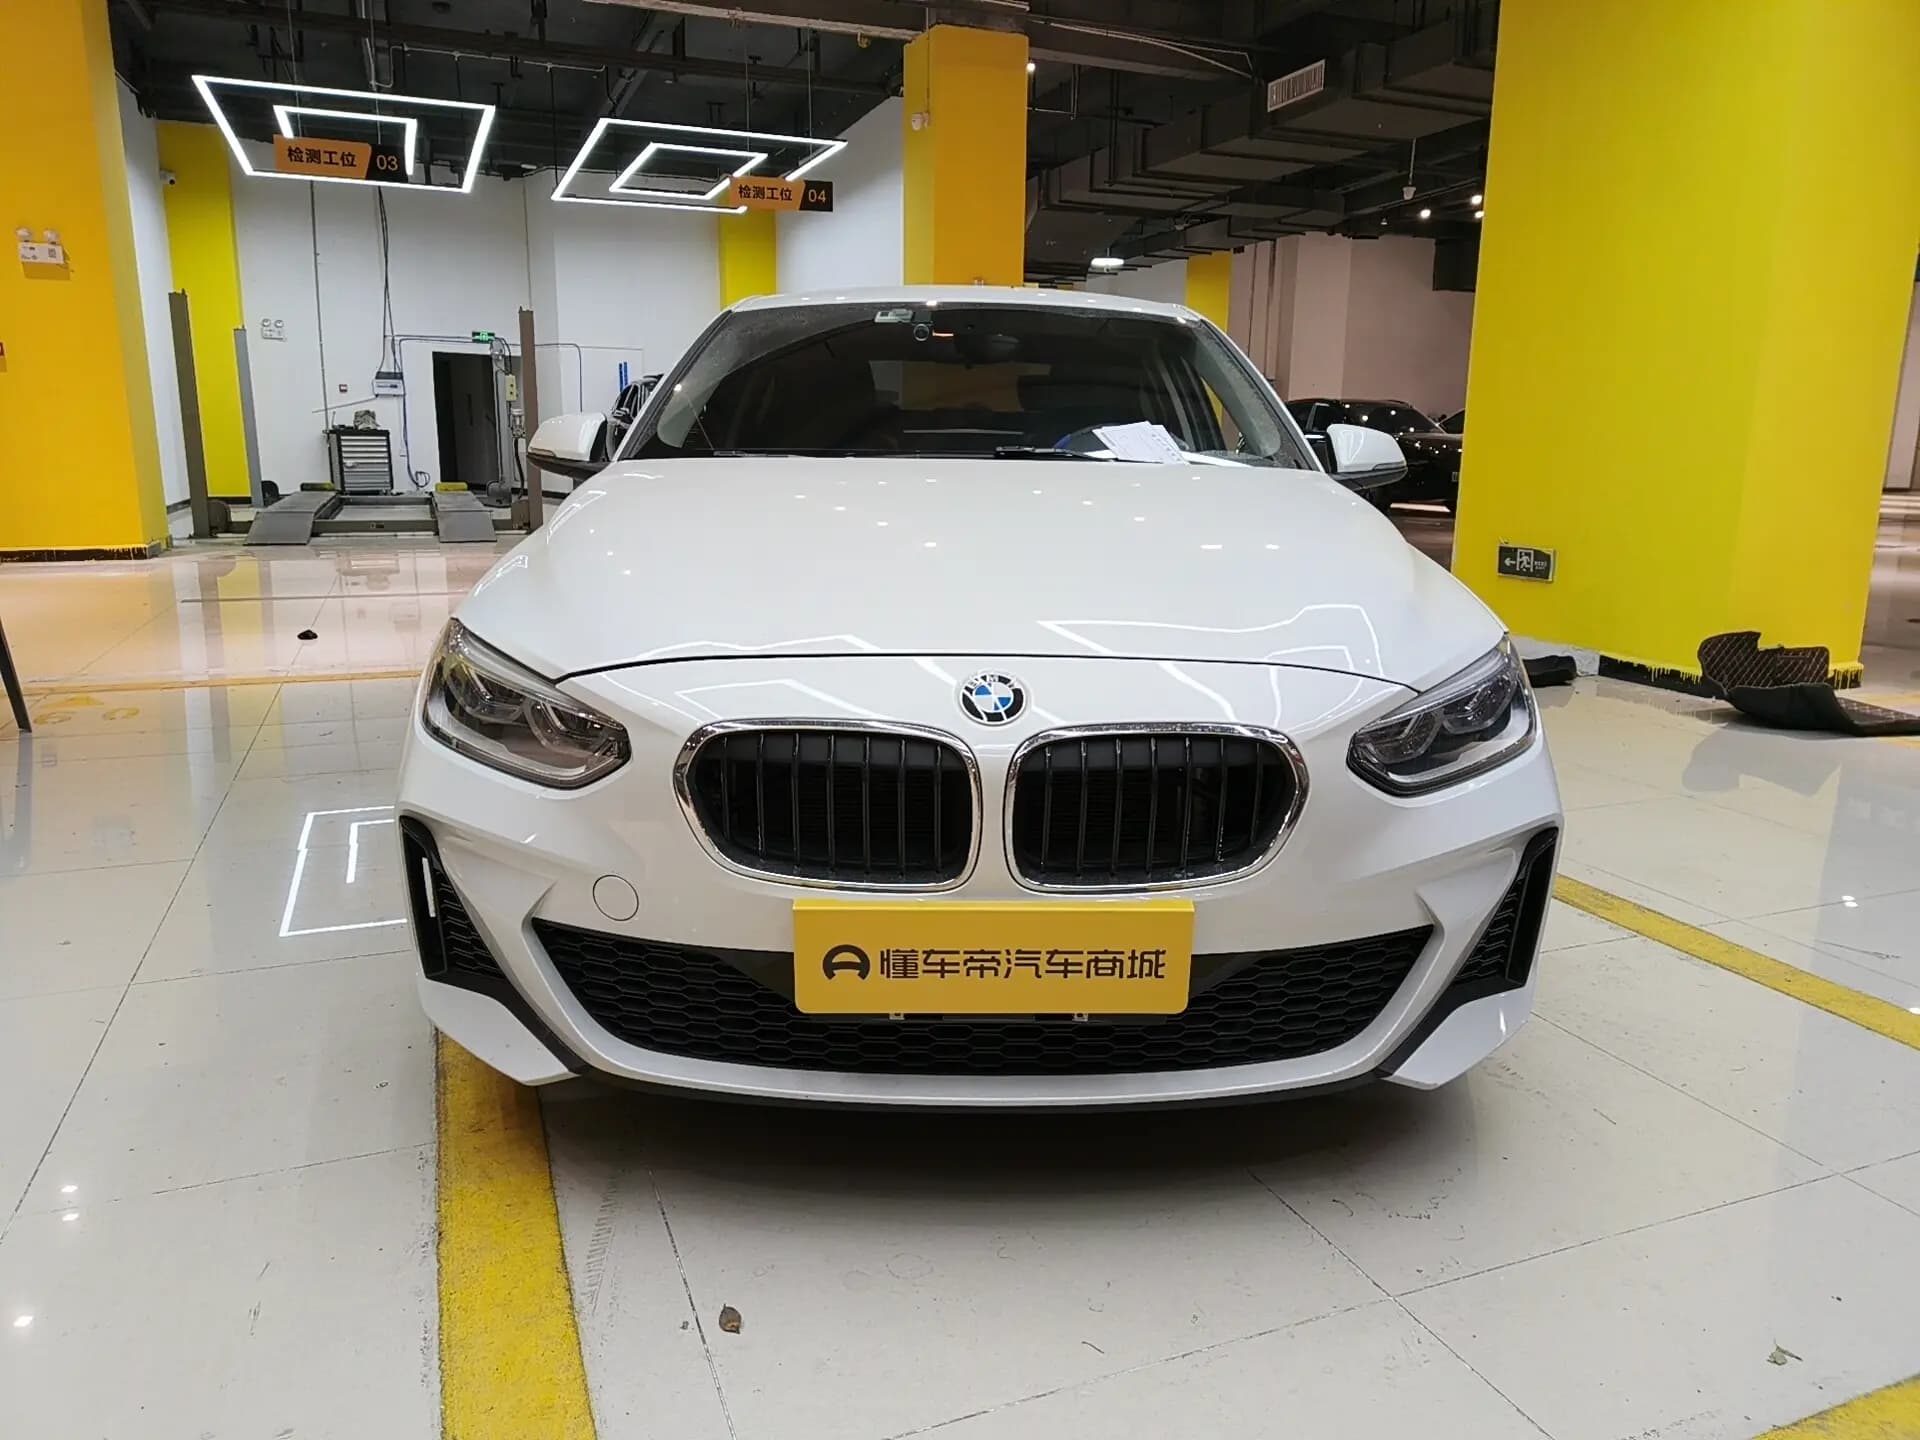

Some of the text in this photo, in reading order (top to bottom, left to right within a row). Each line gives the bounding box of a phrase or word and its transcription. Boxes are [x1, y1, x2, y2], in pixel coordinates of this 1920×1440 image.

[287, 145, 399, 171] 检测工位 03
[738, 184, 827, 203] 检测工位 04
[879, 948, 1167, 979] 懂车帝汽车商城
